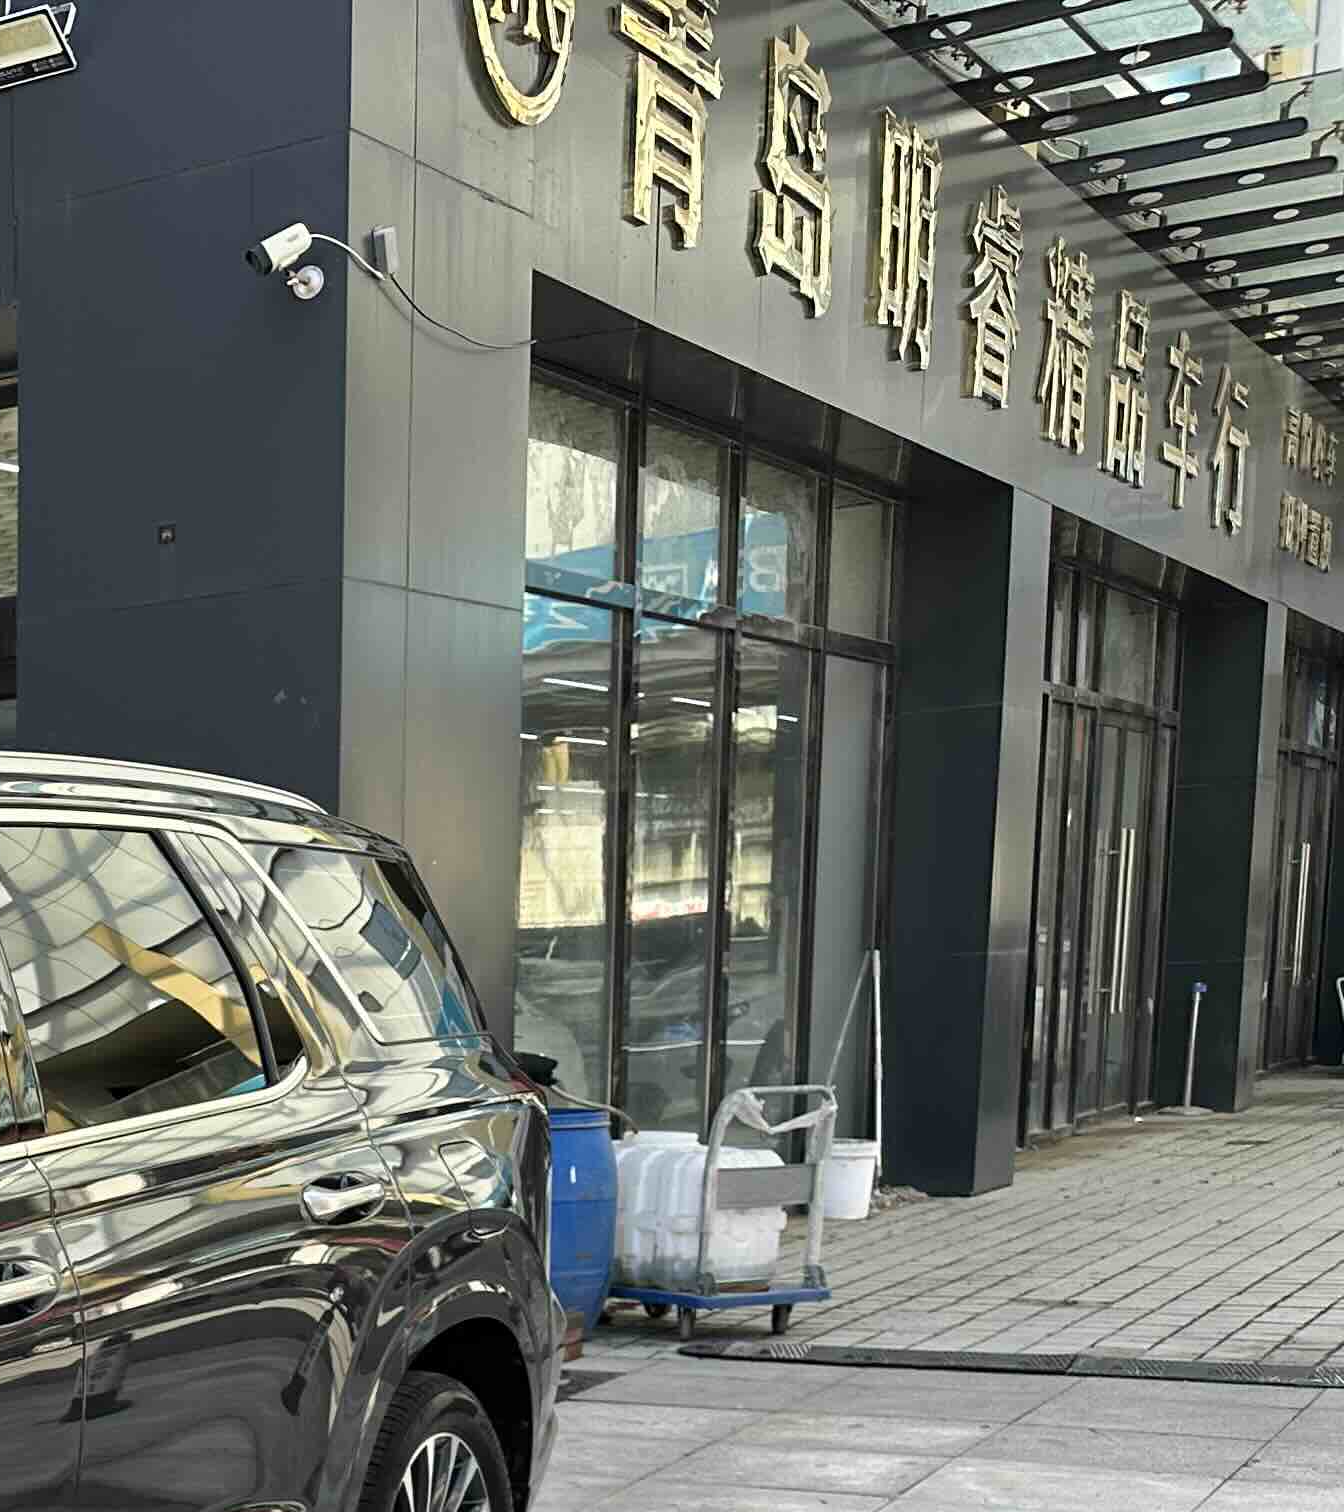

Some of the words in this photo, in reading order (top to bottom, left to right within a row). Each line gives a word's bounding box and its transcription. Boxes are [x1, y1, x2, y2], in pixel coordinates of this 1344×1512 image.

[610, 0, 1253, 538] 青岛明睿精品车行
